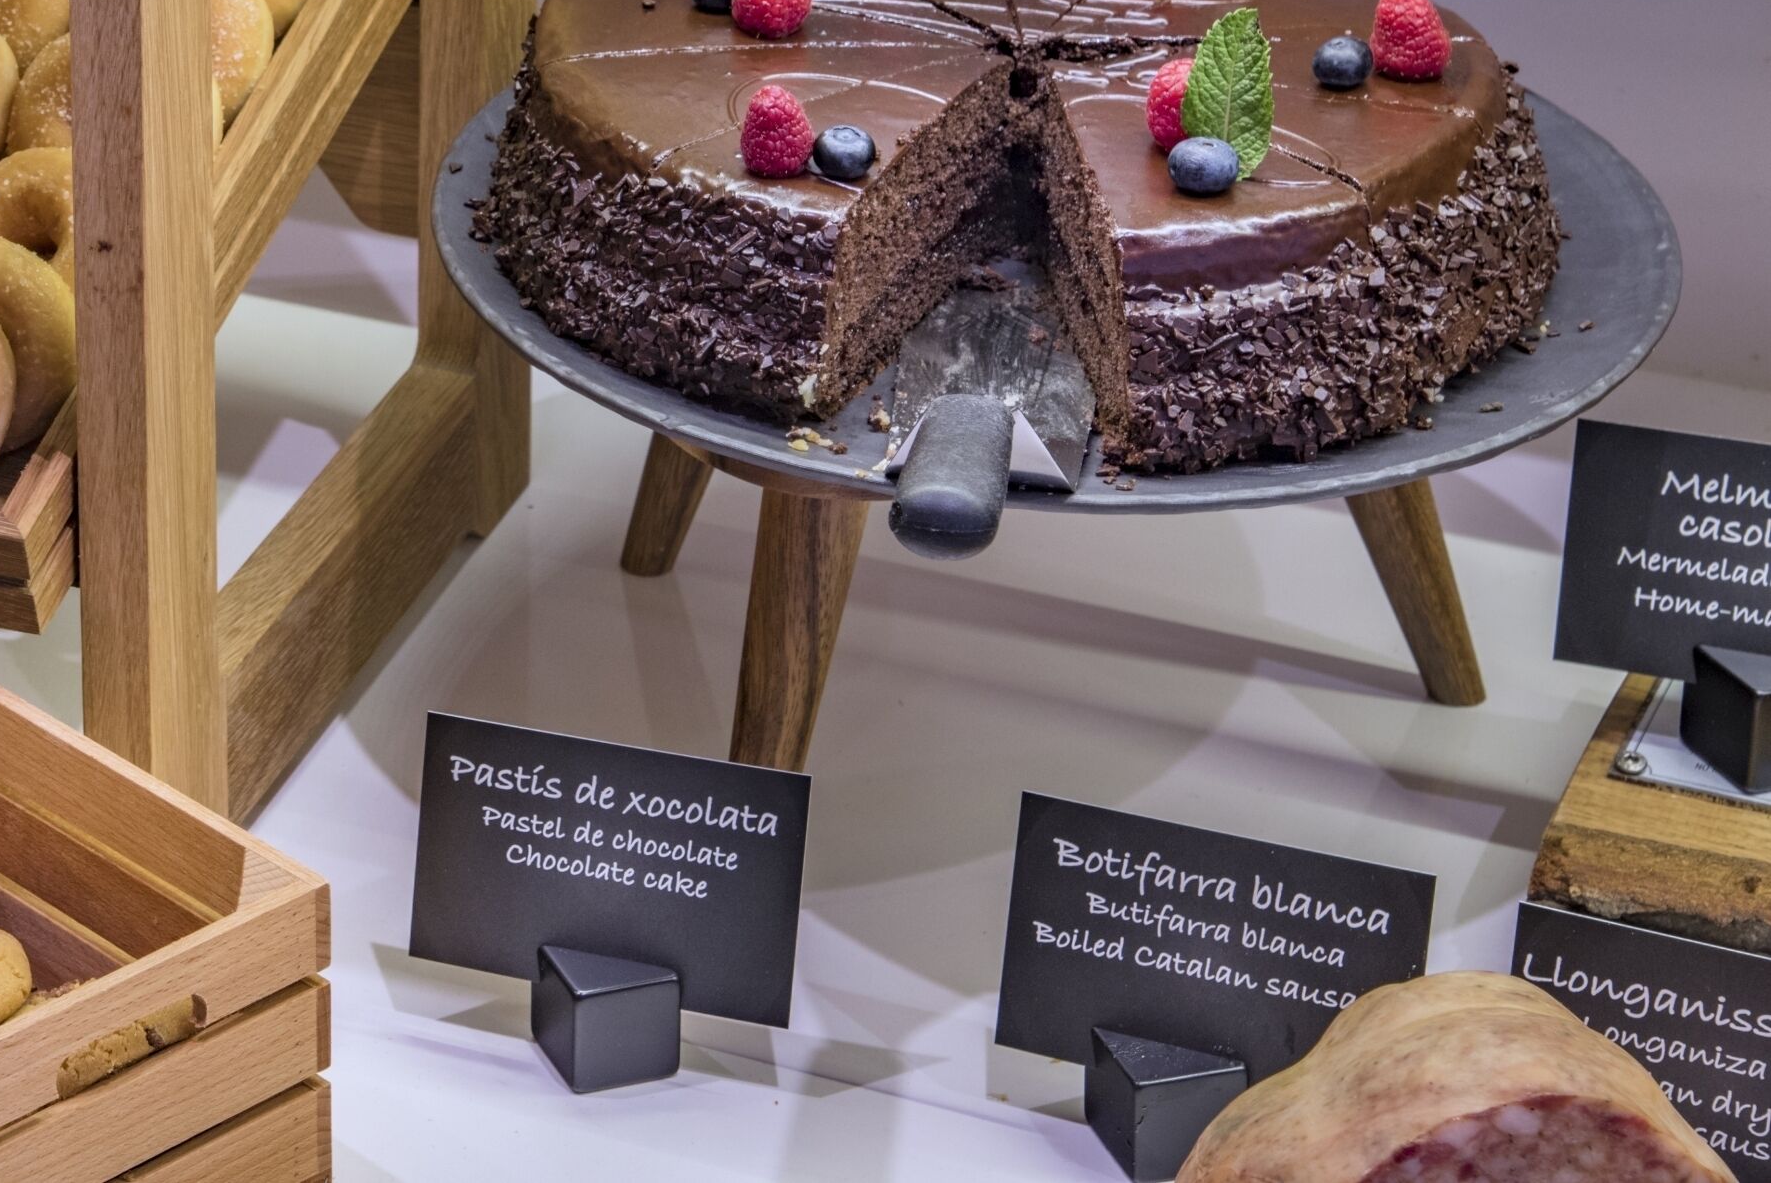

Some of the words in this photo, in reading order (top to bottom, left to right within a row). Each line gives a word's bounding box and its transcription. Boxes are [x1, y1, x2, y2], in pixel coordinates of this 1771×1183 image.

[1660, 470, 1771, 510] Melm
[1678, 514, 1771, 549] casol
[1616, 546, 1771, 587] Mermelad
[450, 755, 563, 799] Pastís
[574, 774, 615, 810] de
[621, 791, 778, 837] xocolata
[482, 805, 566, 839] Pastel
[573, 820, 604, 848] de
[611, 829, 738, 871] chocolate
[505, 843, 635, 886] Chocolate
[643, 870, 708, 899] cake
[1053, 837, 1237, 903] Botifarra
[1252, 874, 1390, 935] blanca
[1032, 920, 1125, 961] Boiled
[1134, 945, 1258, 990] Catalan
[1085, 891, 1231, 943] Butifarra
[1241, 921, 1345, 968] blanca
[1522, 953, 1771, 1038] Llonganiss
[1583, 1015, 1767, 1080] onganiza
[1711, 1089, 1771, 1137] dry
